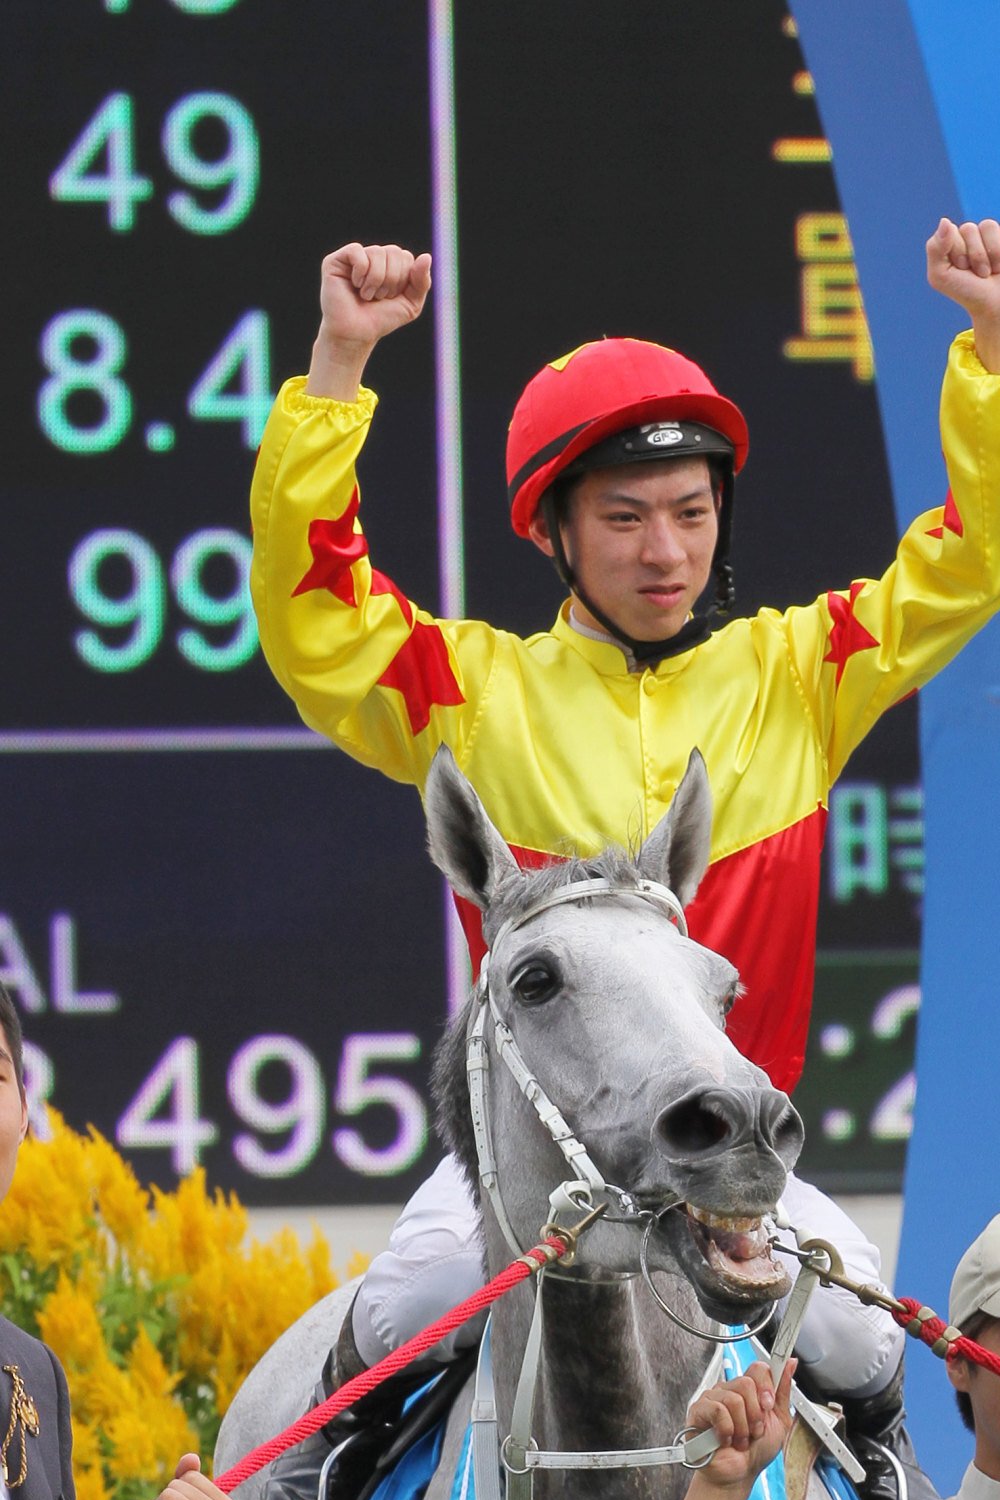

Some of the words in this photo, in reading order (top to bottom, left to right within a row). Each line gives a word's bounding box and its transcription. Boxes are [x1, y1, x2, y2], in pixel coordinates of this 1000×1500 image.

[49, 91, 261, 234] 49
[37, 308, 274, 453] 8.4
[117, 1033, 428, 1178] 495
